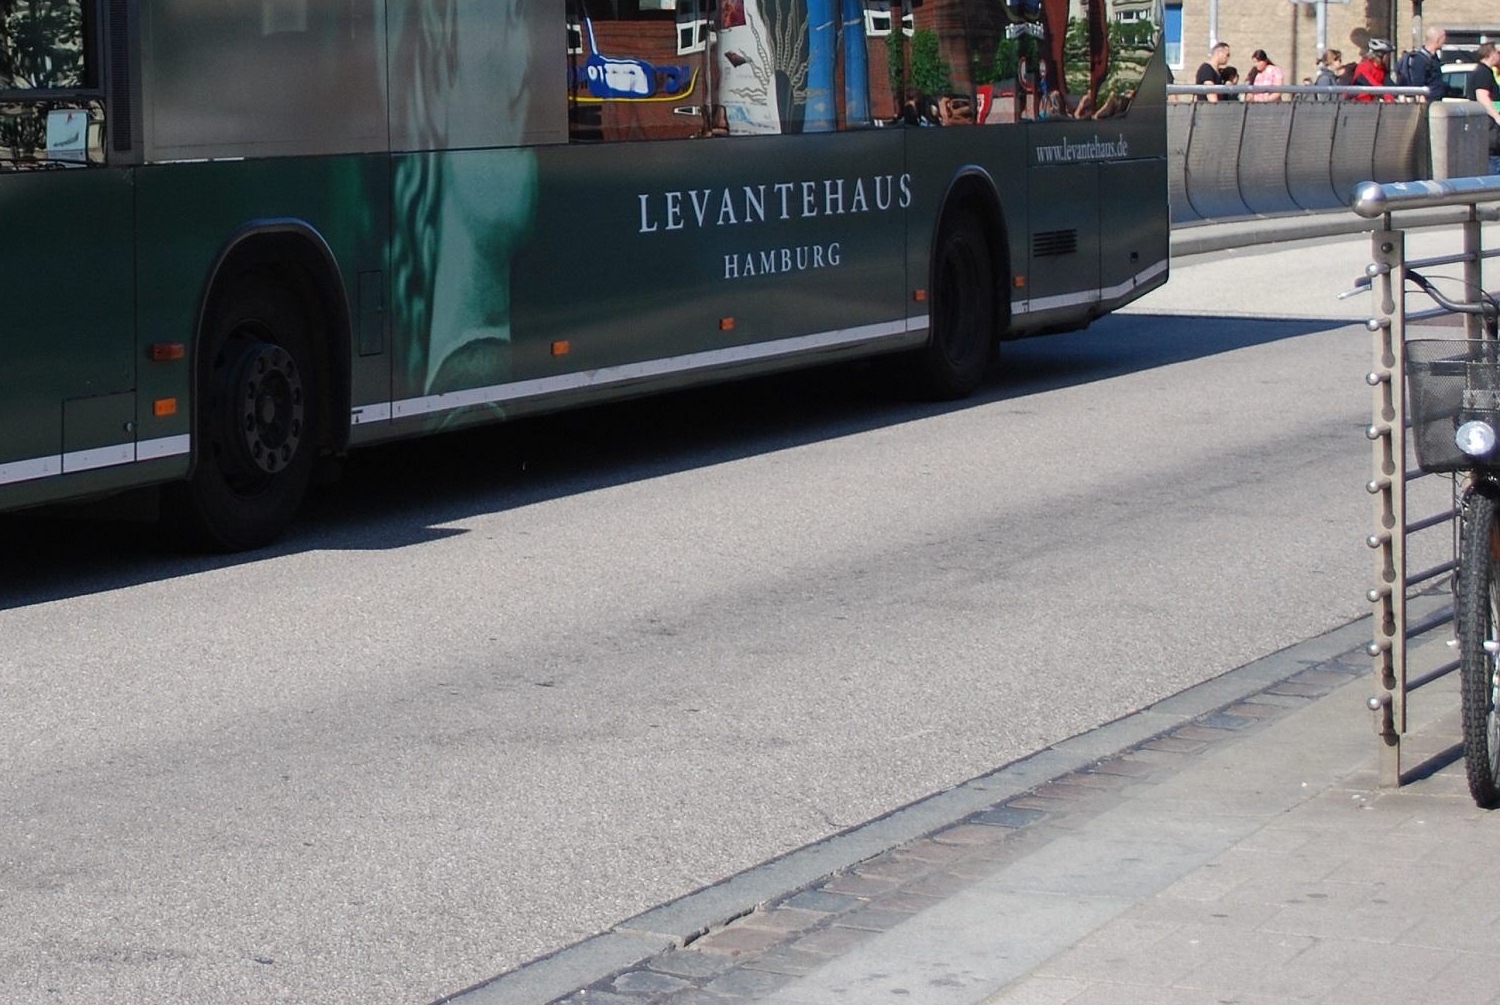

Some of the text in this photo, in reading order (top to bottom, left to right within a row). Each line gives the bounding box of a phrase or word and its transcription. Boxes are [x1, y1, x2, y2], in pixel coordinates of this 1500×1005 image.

[1037, 133, 1128, 163] www.levantehaus.de
[638, 173, 914, 233] LEVANTEHAUS
[724, 242, 842, 279] HAMBURG
